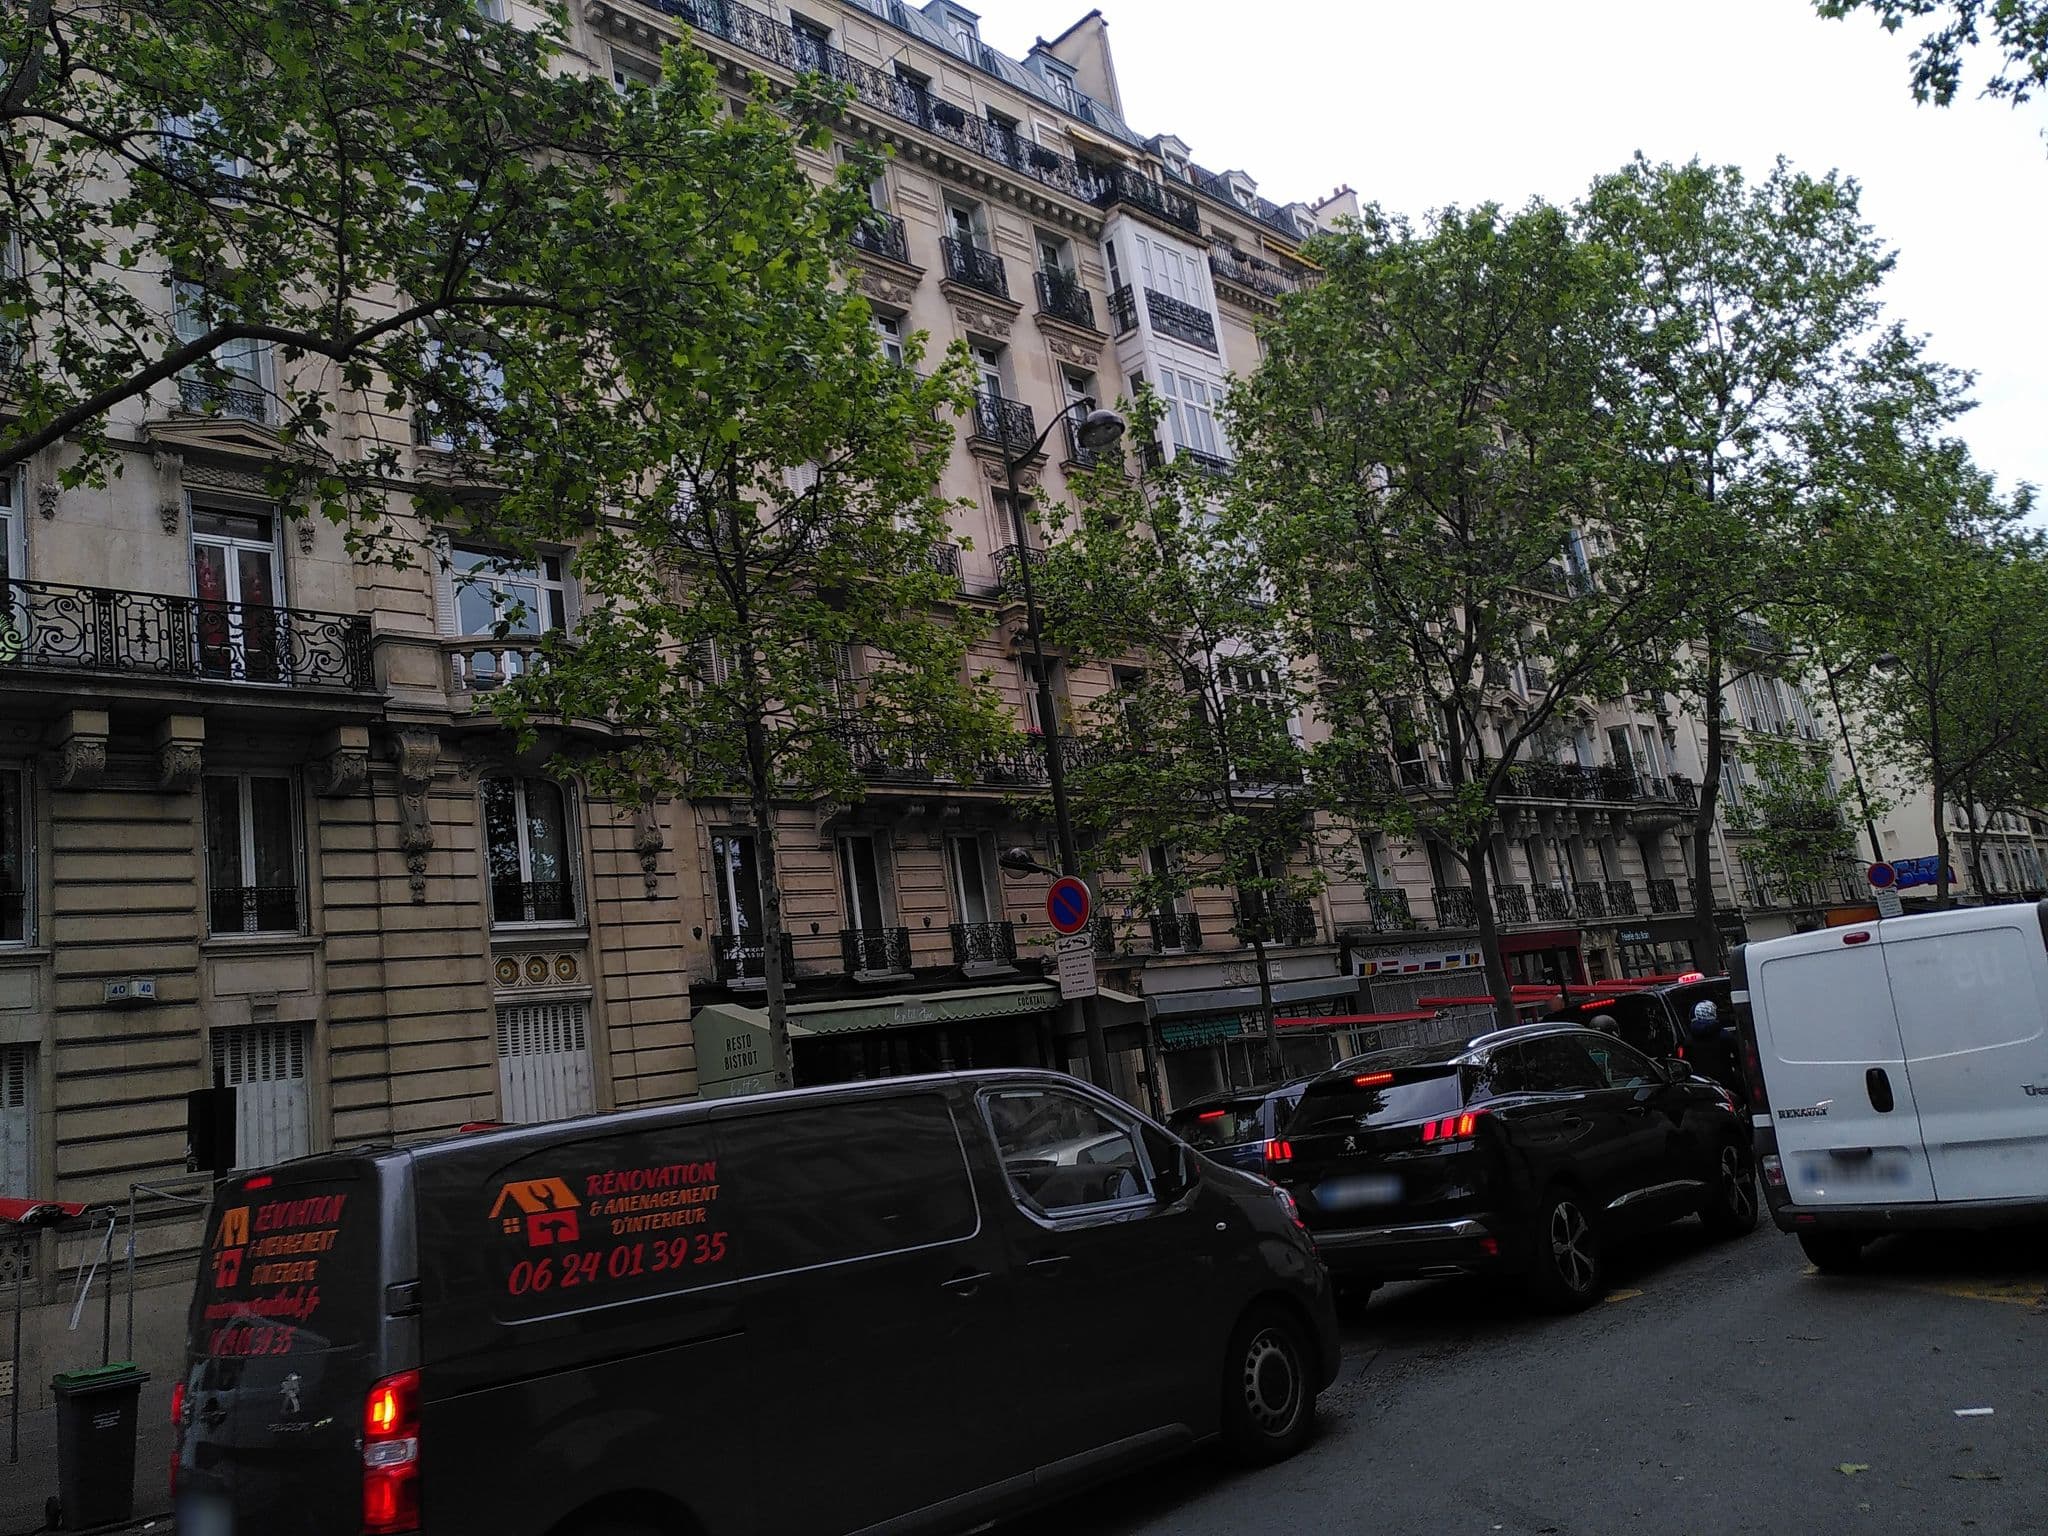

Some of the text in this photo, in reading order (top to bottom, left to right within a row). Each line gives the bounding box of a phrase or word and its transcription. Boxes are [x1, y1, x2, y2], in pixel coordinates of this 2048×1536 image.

[112, 985, 125, 994] 40
[141, 984, 151, 992] 40
[1017, 995, 1046, 1007] COCKTAIL
[726, 1034, 752, 1051] RESTO
[724, 1051, 758, 1070] BISTROT
[1777, 1105, 1829, 1119] RENAULT
[586, 1160, 717, 1196] RÉNOVATION
[589, 1185, 720, 1216] & AMENAGEMENT
[611, 1208, 707, 1235] D'INTERIEUR
[508, 1232, 729, 1296] 06 24 01 39 35
